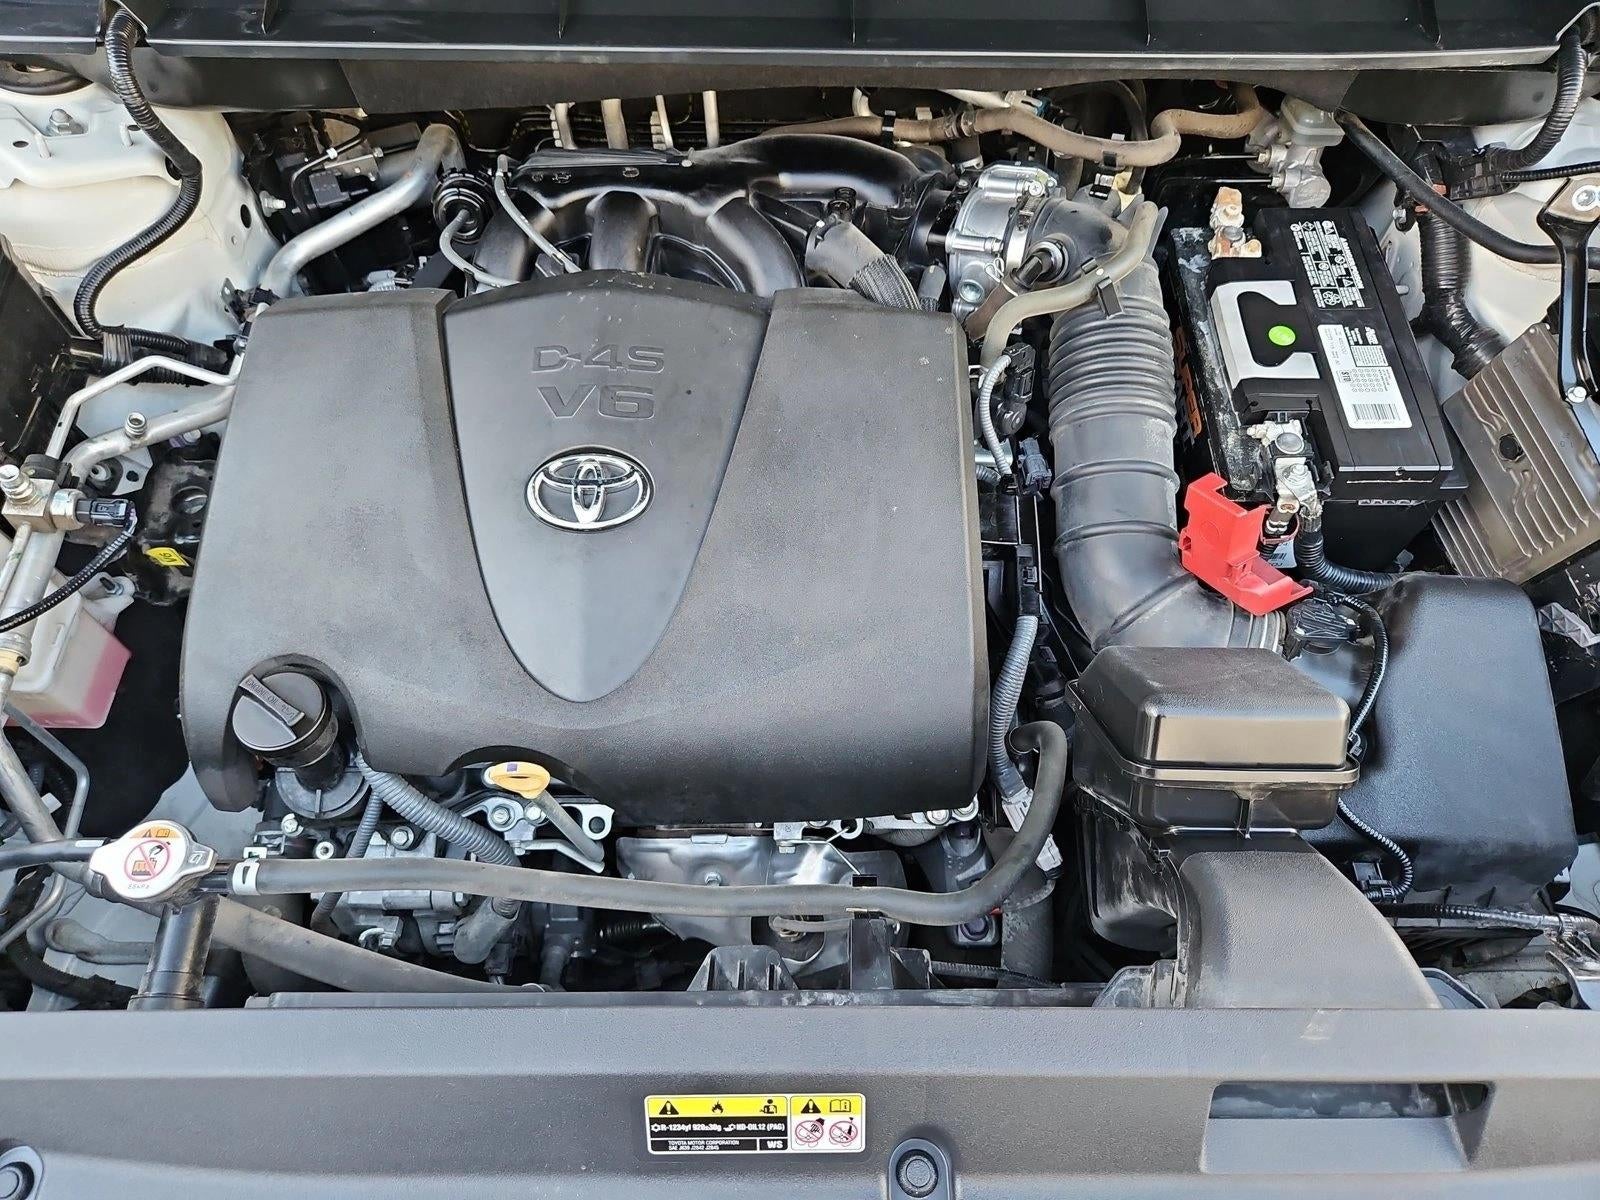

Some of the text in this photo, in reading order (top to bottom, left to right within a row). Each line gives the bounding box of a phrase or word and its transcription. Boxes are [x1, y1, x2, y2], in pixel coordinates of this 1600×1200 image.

[532, 344, 664, 373] D-4S
[536, 384, 656, 419] V6
[767, 1123, 785, 1132] (PAG)
[767, 1140, 784, 1149] WS
